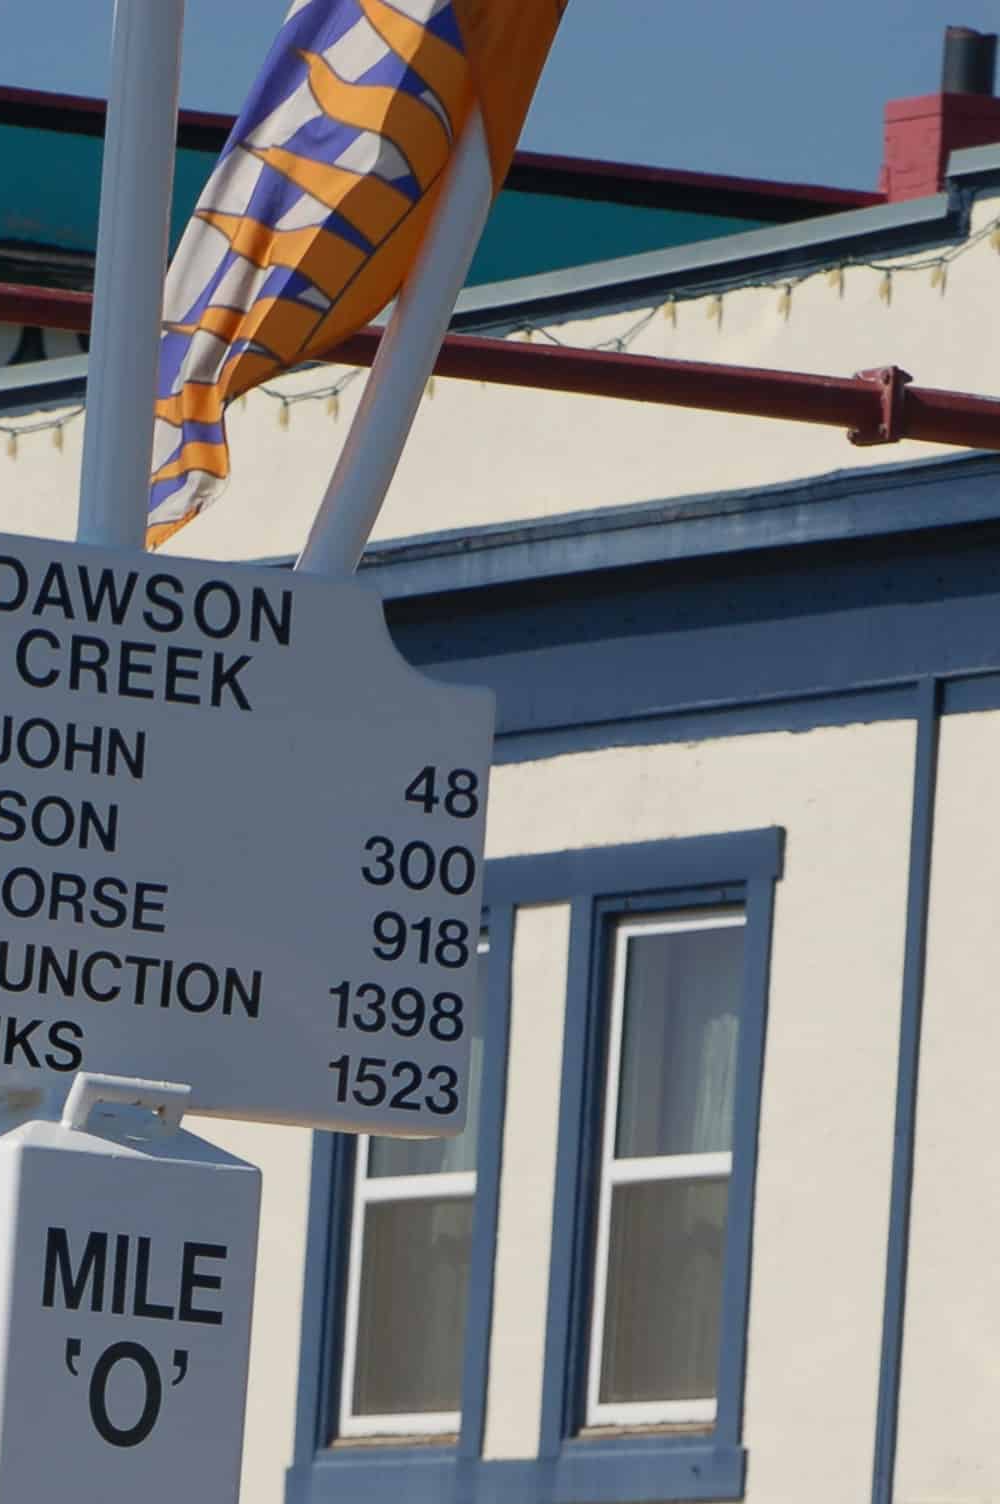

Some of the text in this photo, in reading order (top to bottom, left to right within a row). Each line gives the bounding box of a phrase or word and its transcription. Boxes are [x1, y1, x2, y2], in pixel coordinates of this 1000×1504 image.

[15, 628, 252, 711] CREEK
[404, 765, 479, 819] 48
[361, 835, 475, 896] 300
[372, 911, 470, 970] 918
[329, 981, 464, 1042] 1398
[328, 1054, 459, 1115] 1523
[42, 1228, 228, 1325] MILE
